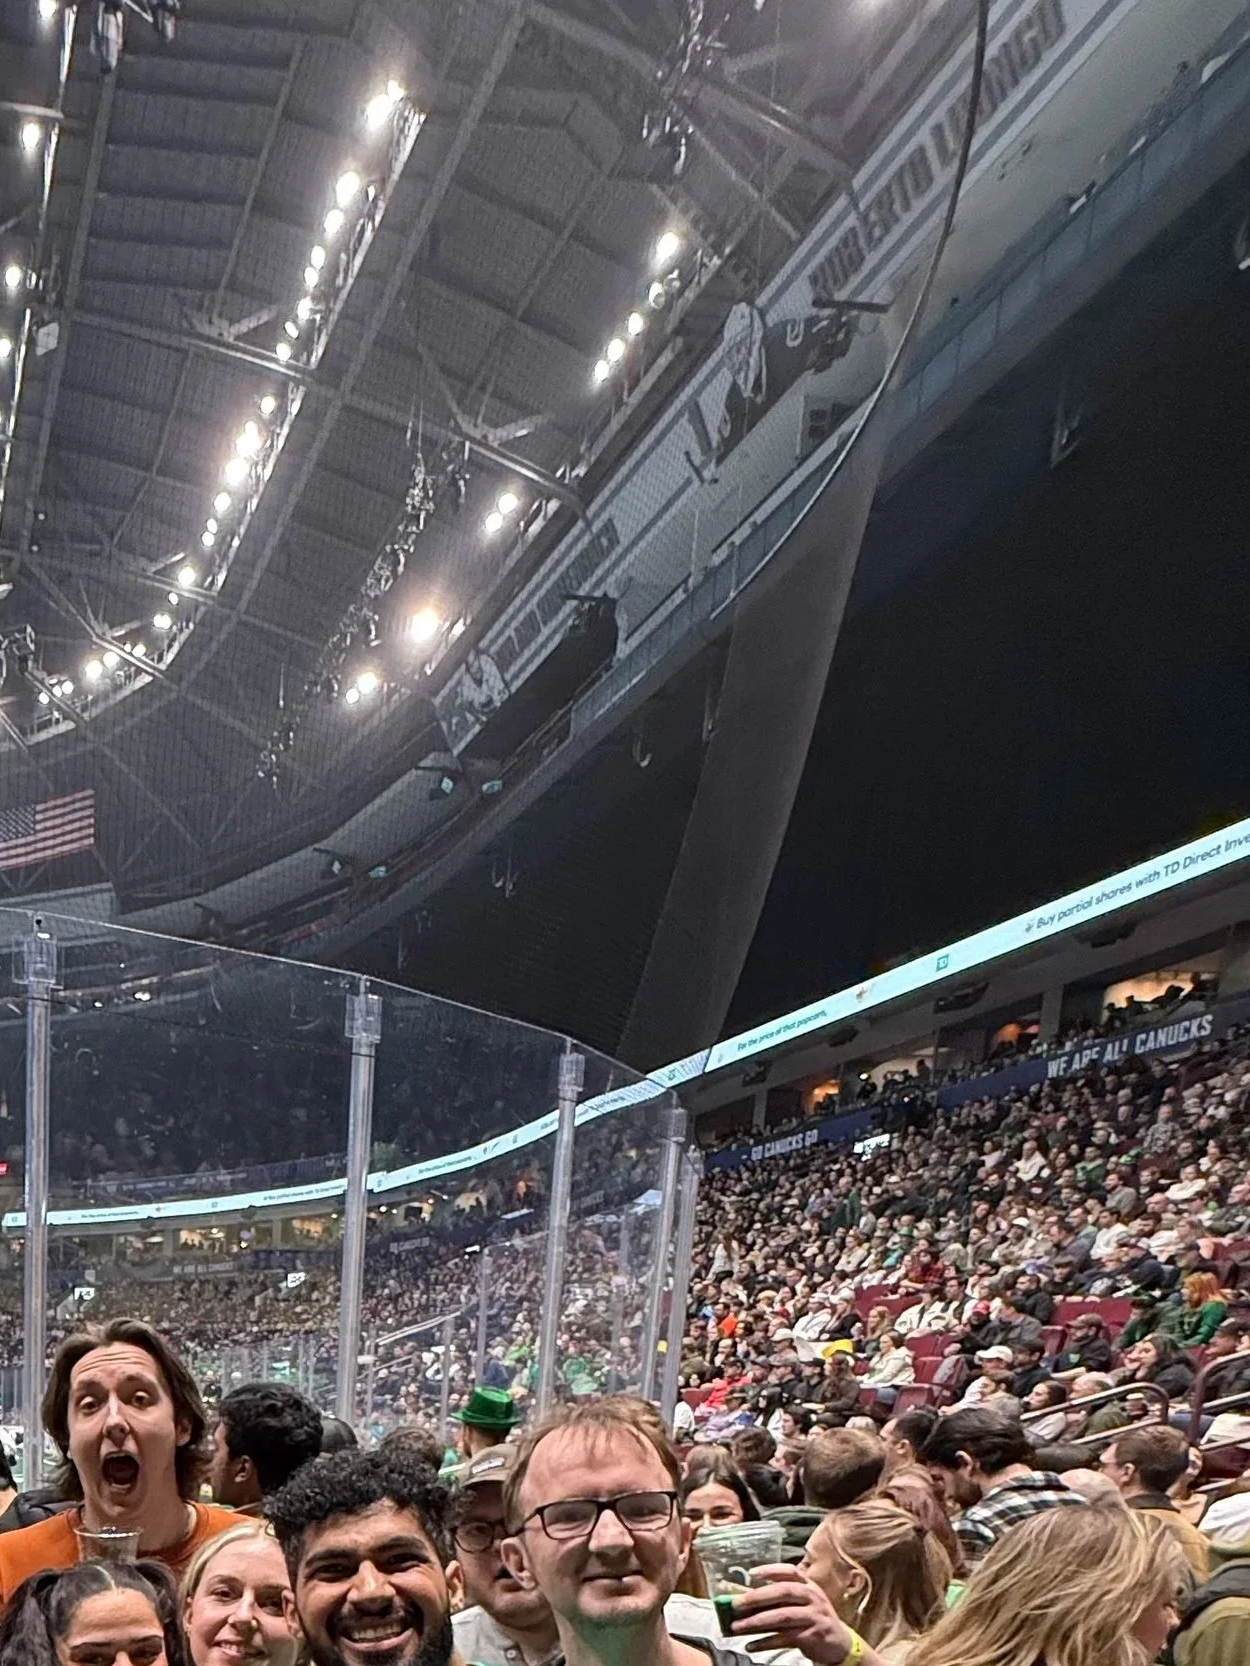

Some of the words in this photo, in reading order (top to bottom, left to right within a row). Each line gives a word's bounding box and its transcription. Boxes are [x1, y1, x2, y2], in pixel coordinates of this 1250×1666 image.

[1036, 913, 1057, 929] Buy
[1057, 895, 1094, 921] partial
[1095, 881, 1133, 906] shares
[1135, 869, 1161, 889] with
[1163, 860, 1180, 877] TD
[1182, 844, 1222, 870] Direct
[1134, 1014, 1214, 1054] CANUCKS
[764, 1132, 804, 1159] CANUCKS
[805, 1129, 818, 1145] GO
